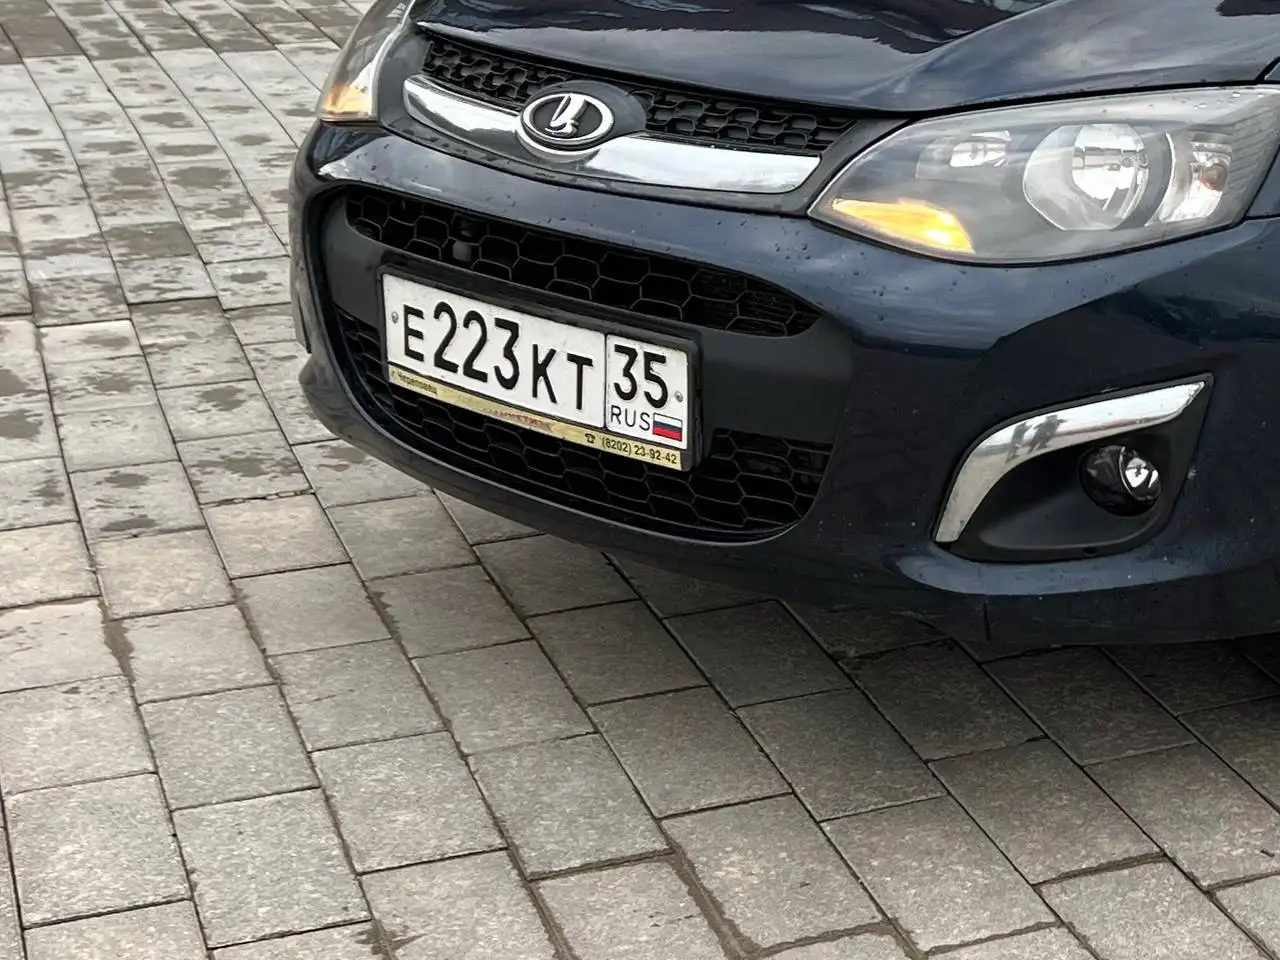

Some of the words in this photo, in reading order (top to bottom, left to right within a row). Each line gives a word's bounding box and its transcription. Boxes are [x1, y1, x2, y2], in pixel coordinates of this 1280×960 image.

[613, 344, 669, 409] 35
[610, 406, 651, 432] RUS
[601, 436, 632, 456] (8202)
[634, 444, 677, 465] 23-92-42
